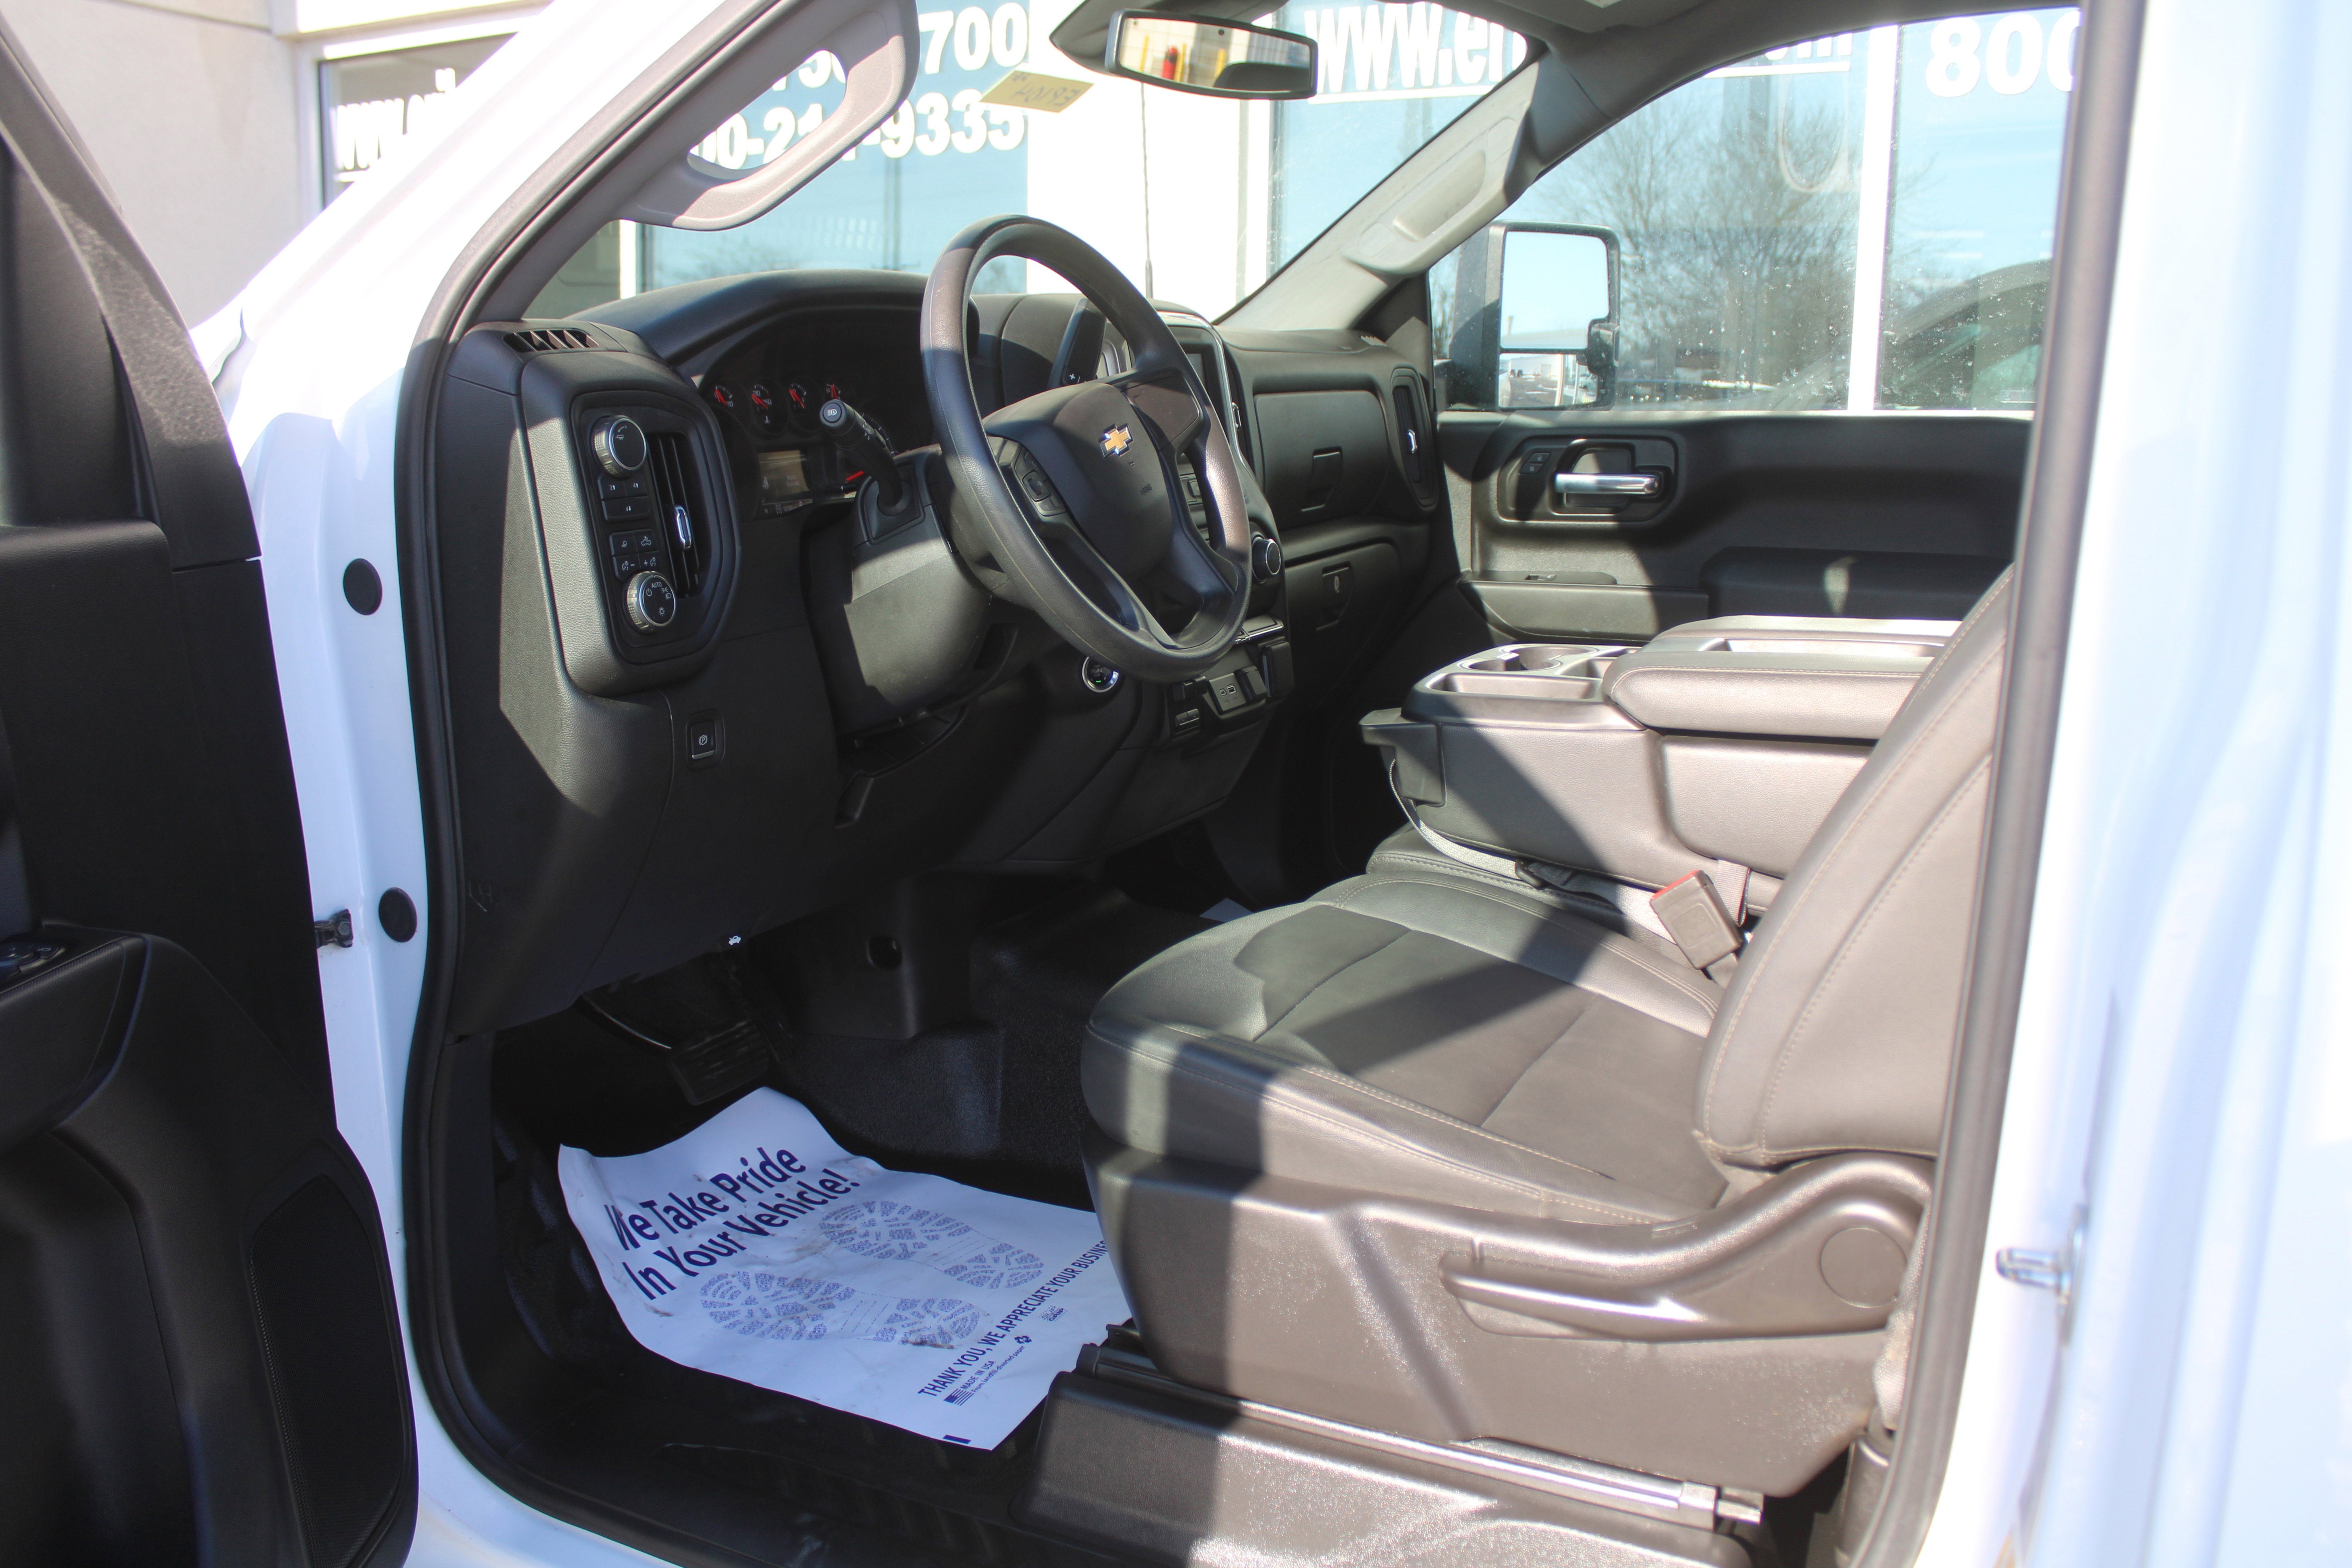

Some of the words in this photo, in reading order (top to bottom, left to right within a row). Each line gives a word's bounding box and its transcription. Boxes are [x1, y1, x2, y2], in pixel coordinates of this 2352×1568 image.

[622, 1262, 677, 1300] In
[653, 1231, 747, 1277] Your
[722, 1168, 860, 1236] Vehicle!
[639, 1192, 730, 1234] Take
[709, 1147, 806, 1203] Pride
[917, 1366, 966, 1396] THANK
[953, 1348, 993, 1367] YOU,
[977, 1331, 1007, 1346] WE
[996, 1286, 1059, 1332] APPRECIATE
[1046, 1267, 1083, 1287] YOUR
[960, 1375, 979, 1390] MADE
[981, 1360, 996, 1370] USA
[971, 1382, 985, 1392] From
[981, 1355, 1015, 1383] landfill-diverted
[1013, 1345, 1026, 1357] paper
